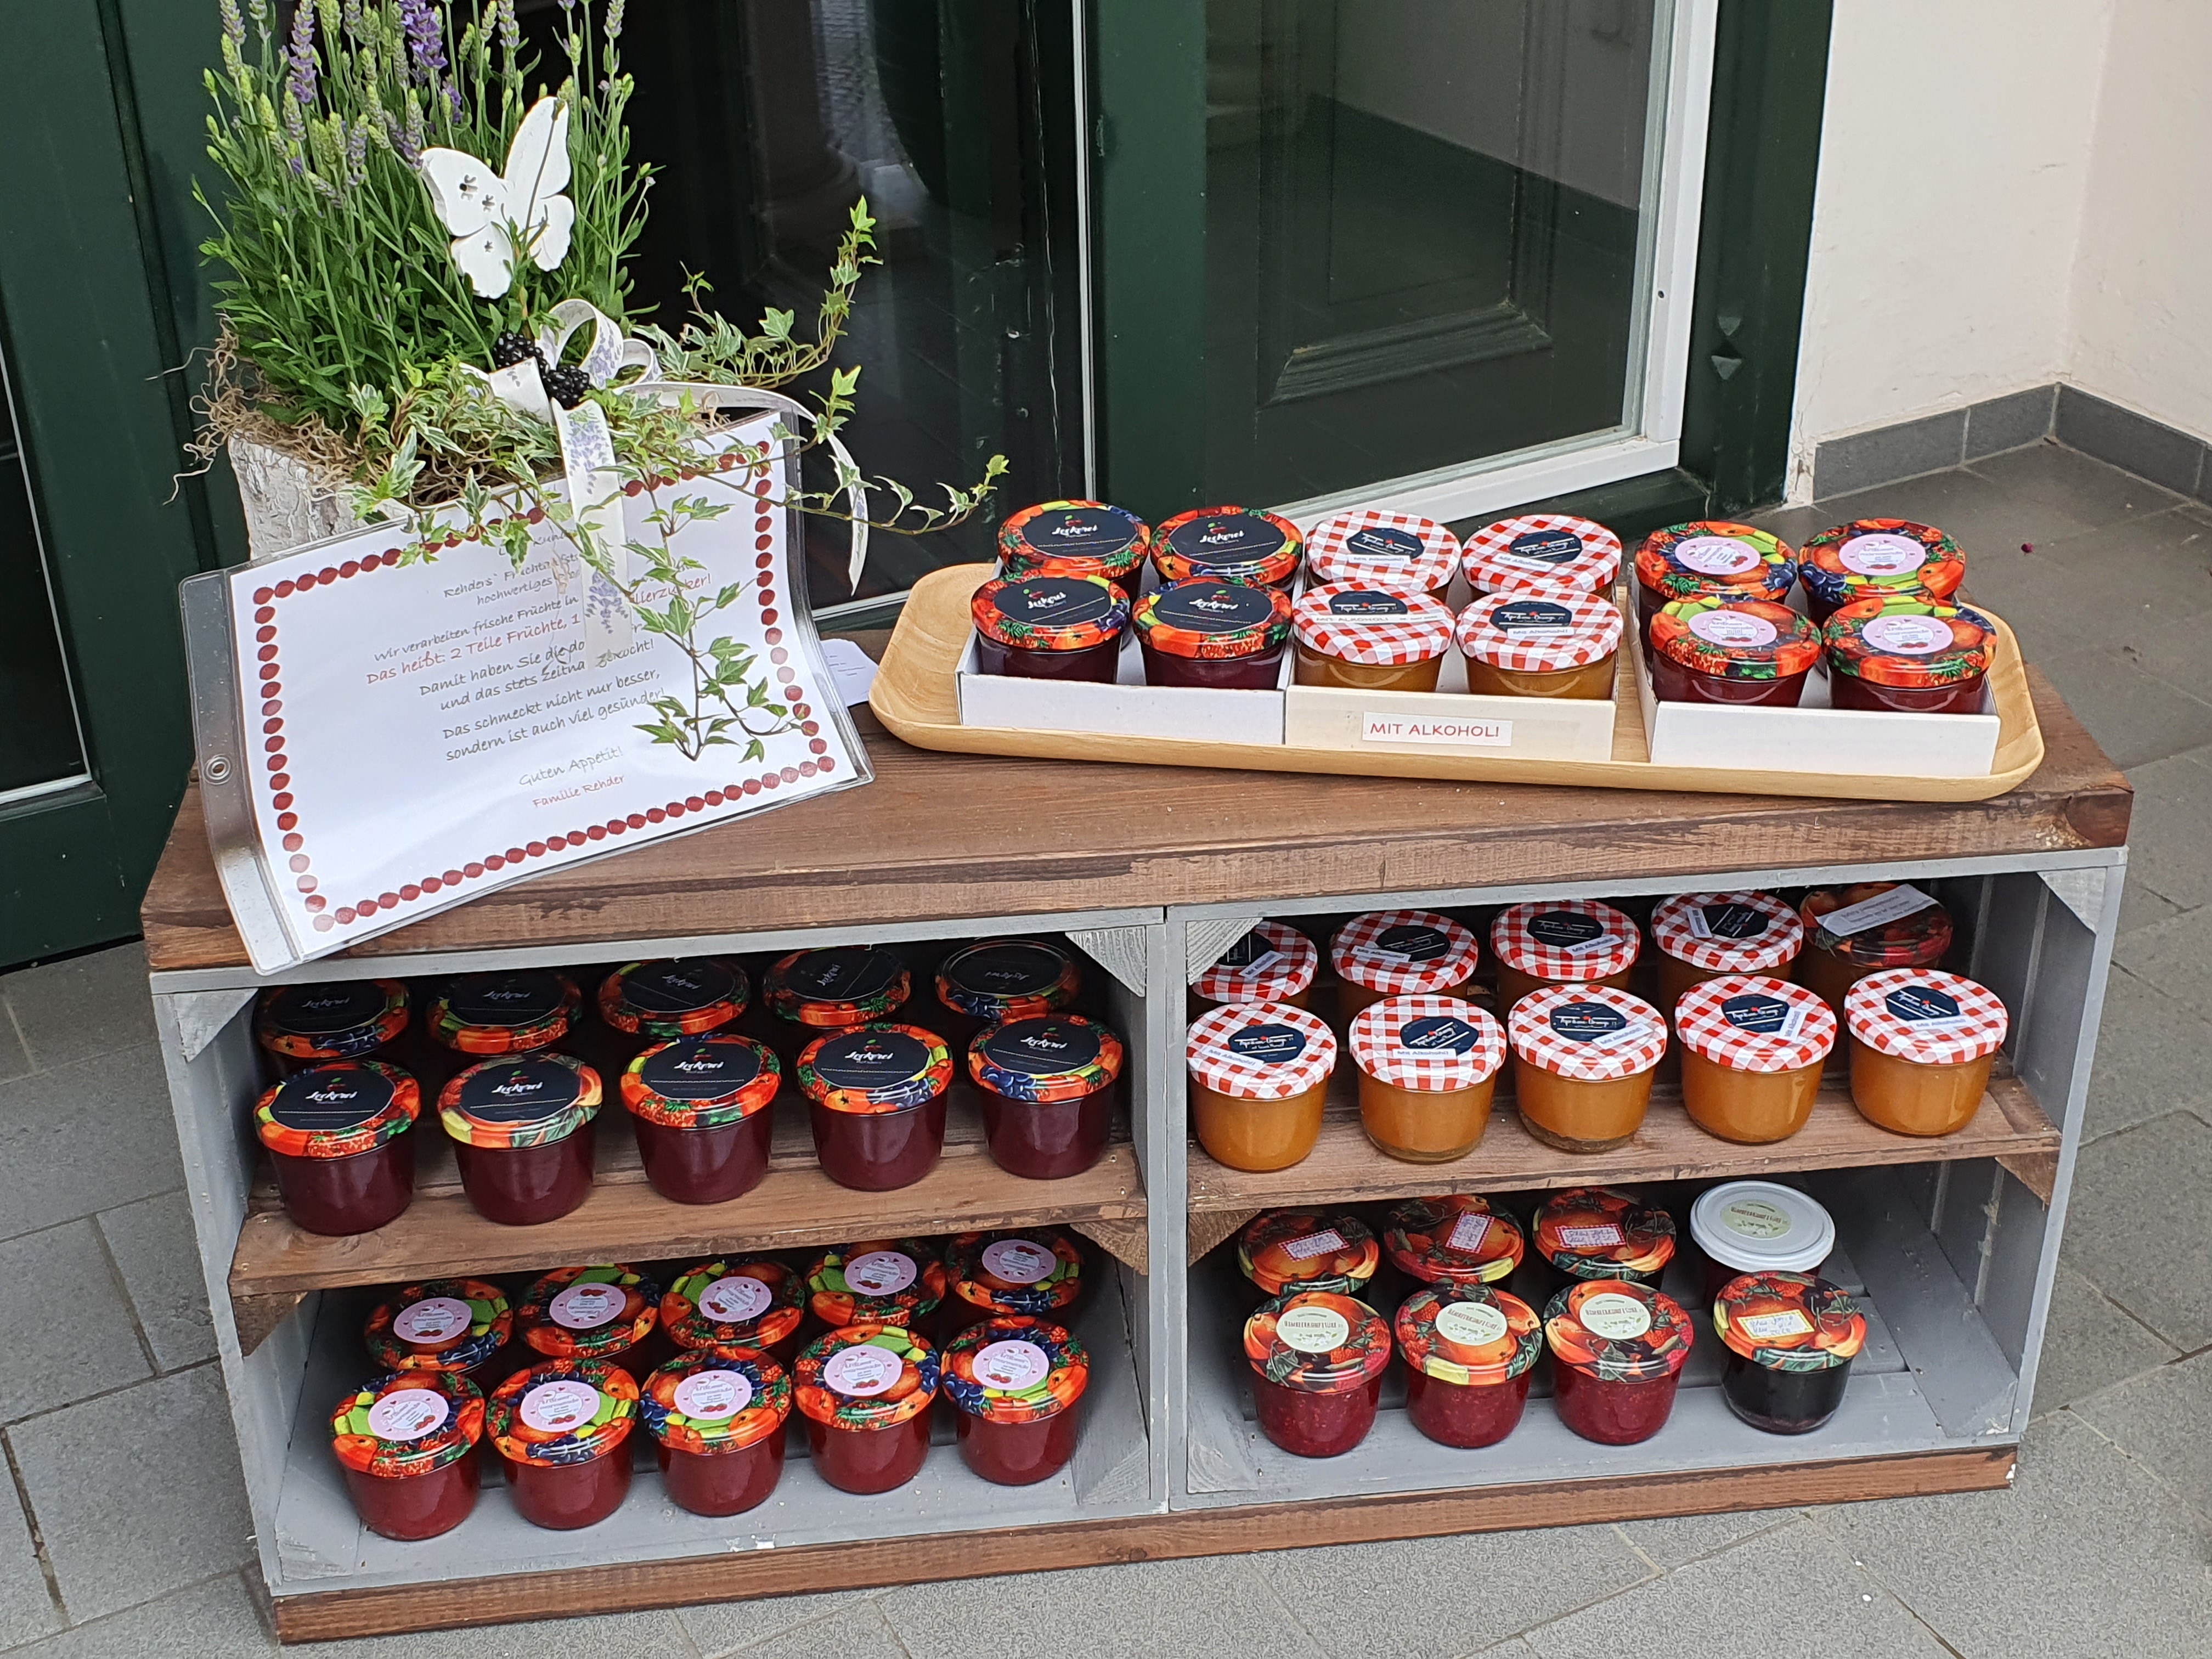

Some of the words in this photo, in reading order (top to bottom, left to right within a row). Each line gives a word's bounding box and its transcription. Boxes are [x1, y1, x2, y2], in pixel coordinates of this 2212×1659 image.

[402, 628, 470, 653] verarbeiten
[472, 613, 514, 636] frische
[517, 598, 561, 620] Früchte
[366, 667, 397, 684] Das
[450, 648, 462, 659] 2
[466, 635, 503, 654] Teile
[507, 618, 567, 644] Früchte,
[419, 673, 466, 696] Damit
[471, 661, 514, 681] haben
[516, 652, 541, 669] Sie
[440, 694, 471, 712] und
[475, 686, 501, 701] das
[504, 674, 538, 693] stets
[443, 726, 471, 740] Das
[474, 702, 543, 731] schmeckt
[545, 690, 584, 709] nicht
[586, 681, 613, 698] nur
[616, 668, 661, 689] besser,
[446, 737, 506, 761] sondern
[507, 729, 529, 743] ist
[531, 716, 566, 736] auch
[568, 707, 595, 725] viel
[1370, 723, 1403, 735] MIT
[1408, 724, 1499, 737] ALKOHOL!
[519, 766, 566, 787] Guten
[568, 746, 623, 774] Appetit!
[532, 789, 581, 808] Familie
[583, 774, 625, 794] Rehder
